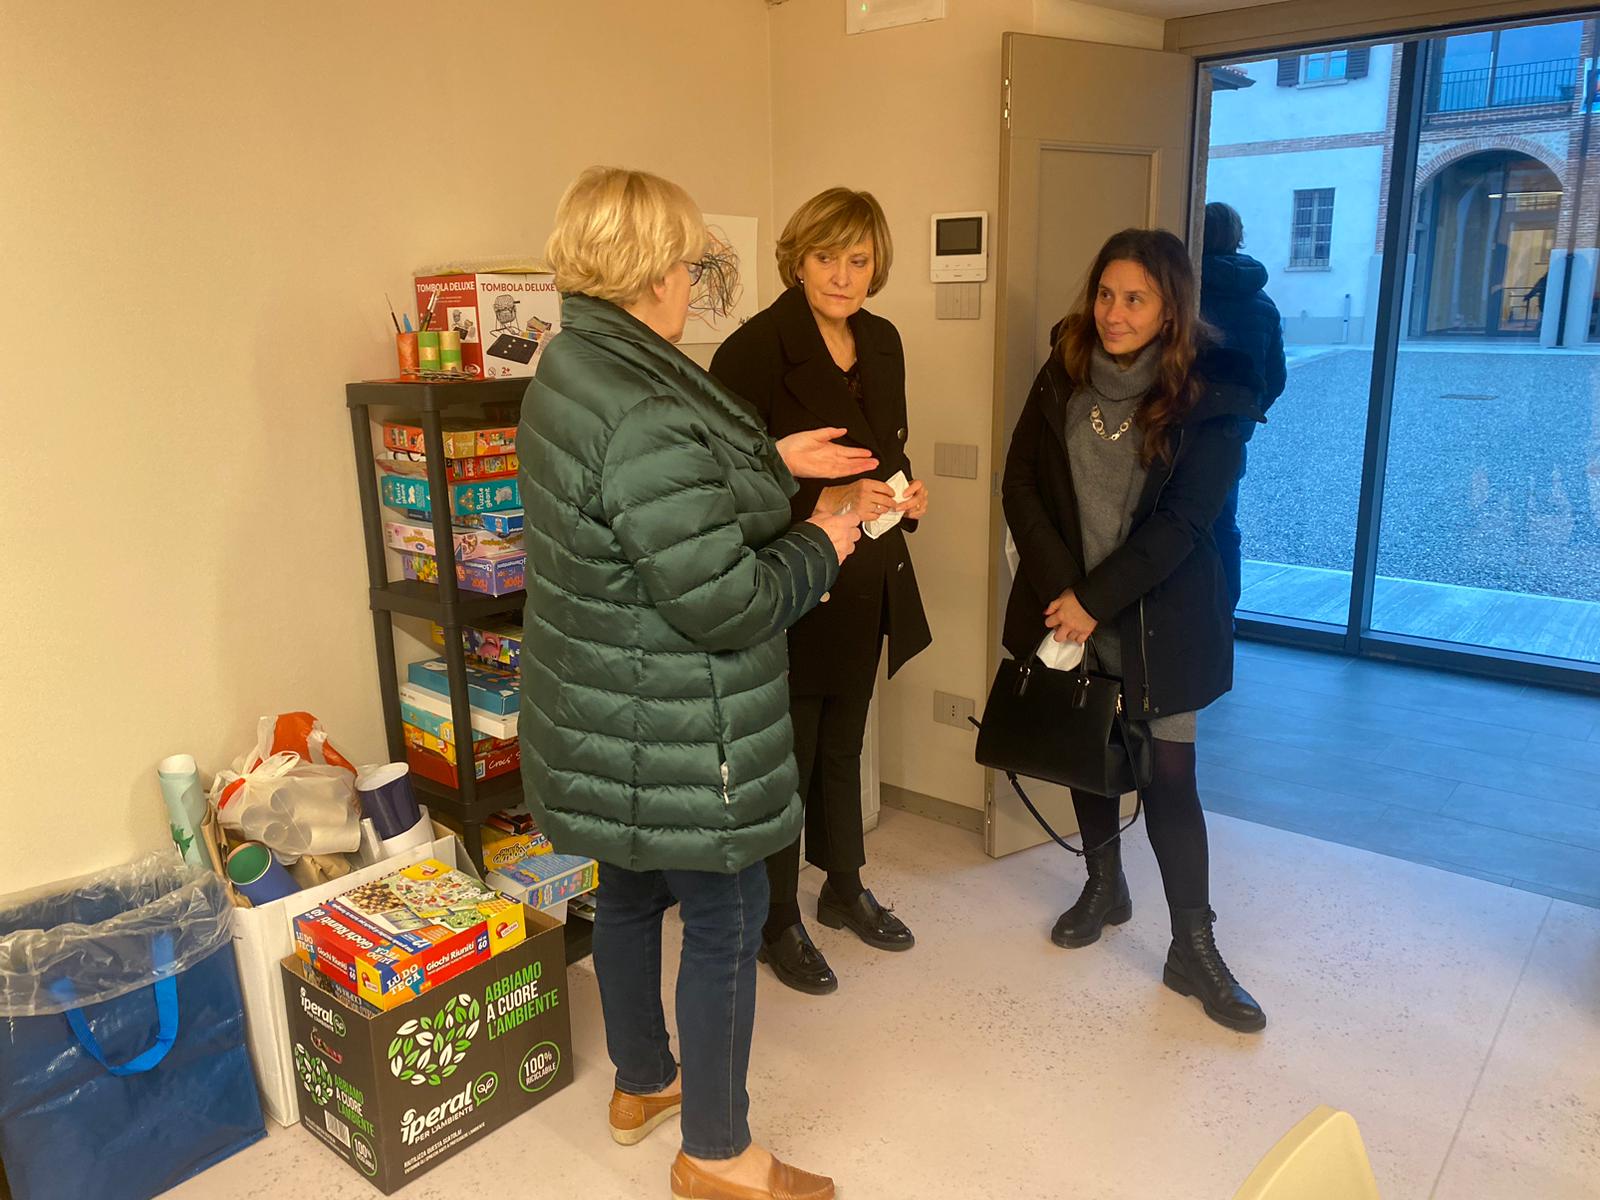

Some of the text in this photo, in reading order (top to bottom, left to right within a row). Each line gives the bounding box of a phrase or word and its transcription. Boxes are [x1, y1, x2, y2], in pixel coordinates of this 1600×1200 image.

[417, 281, 475, 293] TOMBOLA DELUXE
[481, 283, 555, 292] TOMBOLA DELUXE
[476, 488, 484, 510] Puzzle
[484, 487, 493, 508] géant
[317, 916, 374, 949] Giochi Riuniti
[478, 939, 488, 951] 60
[298, 940, 315, 953] TECA
[317, 946, 332, 961] Giochi
[426, 953, 450, 971] Giochi
[450, 941, 475, 959] Riuniti
[389, 970, 421, 995] TECA
[485, 960, 542, 1004] ABBIAMO
[300, 986, 334, 1026] iperal
[486, 980, 539, 1023] A CUORE
[487, 988, 559, 1041] L'AMBIENTE
[524, 1051, 552, 1077] 100%
[525, 1062, 557, 1086] RICICLABILE
[335, 1074, 364, 1105] ABBIAMO
[336, 1087, 363, 1117] A CUORE
[337, 1100, 375, 1138] L'AMBIENTE
[400, 1081, 473, 1146] iperal
[415, 1103, 474, 1144] PER L'AMBIENTE
[354, 1138, 372, 1160] 100%
[426, 1141, 443, 1155] QUESTA
